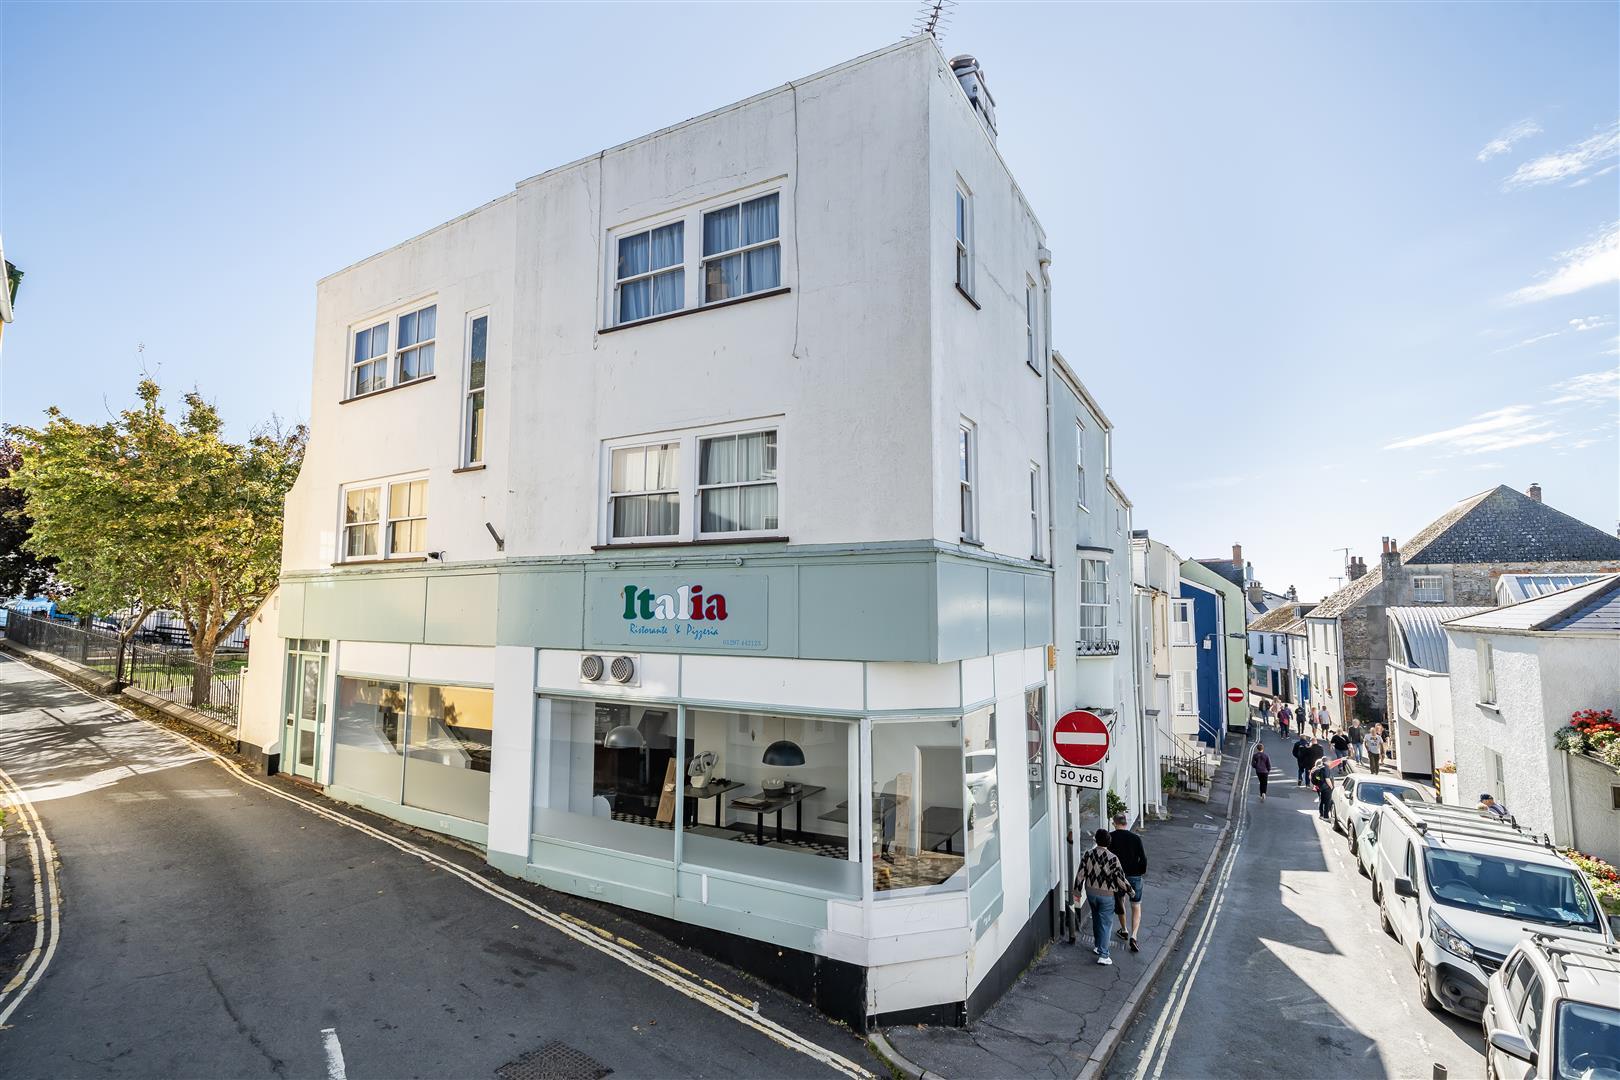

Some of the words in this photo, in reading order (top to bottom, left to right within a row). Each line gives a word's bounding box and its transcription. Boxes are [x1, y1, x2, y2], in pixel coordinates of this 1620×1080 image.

[623, 585, 728, 620] Italia
[630, 623, 668, 634] Ristorante
[674, 623, 681, 634] &
[686, 624, 719, 640] Pizzeria
[1060, 769, 1075, 780] 50
[1079, 773, 1098, 783] yds
